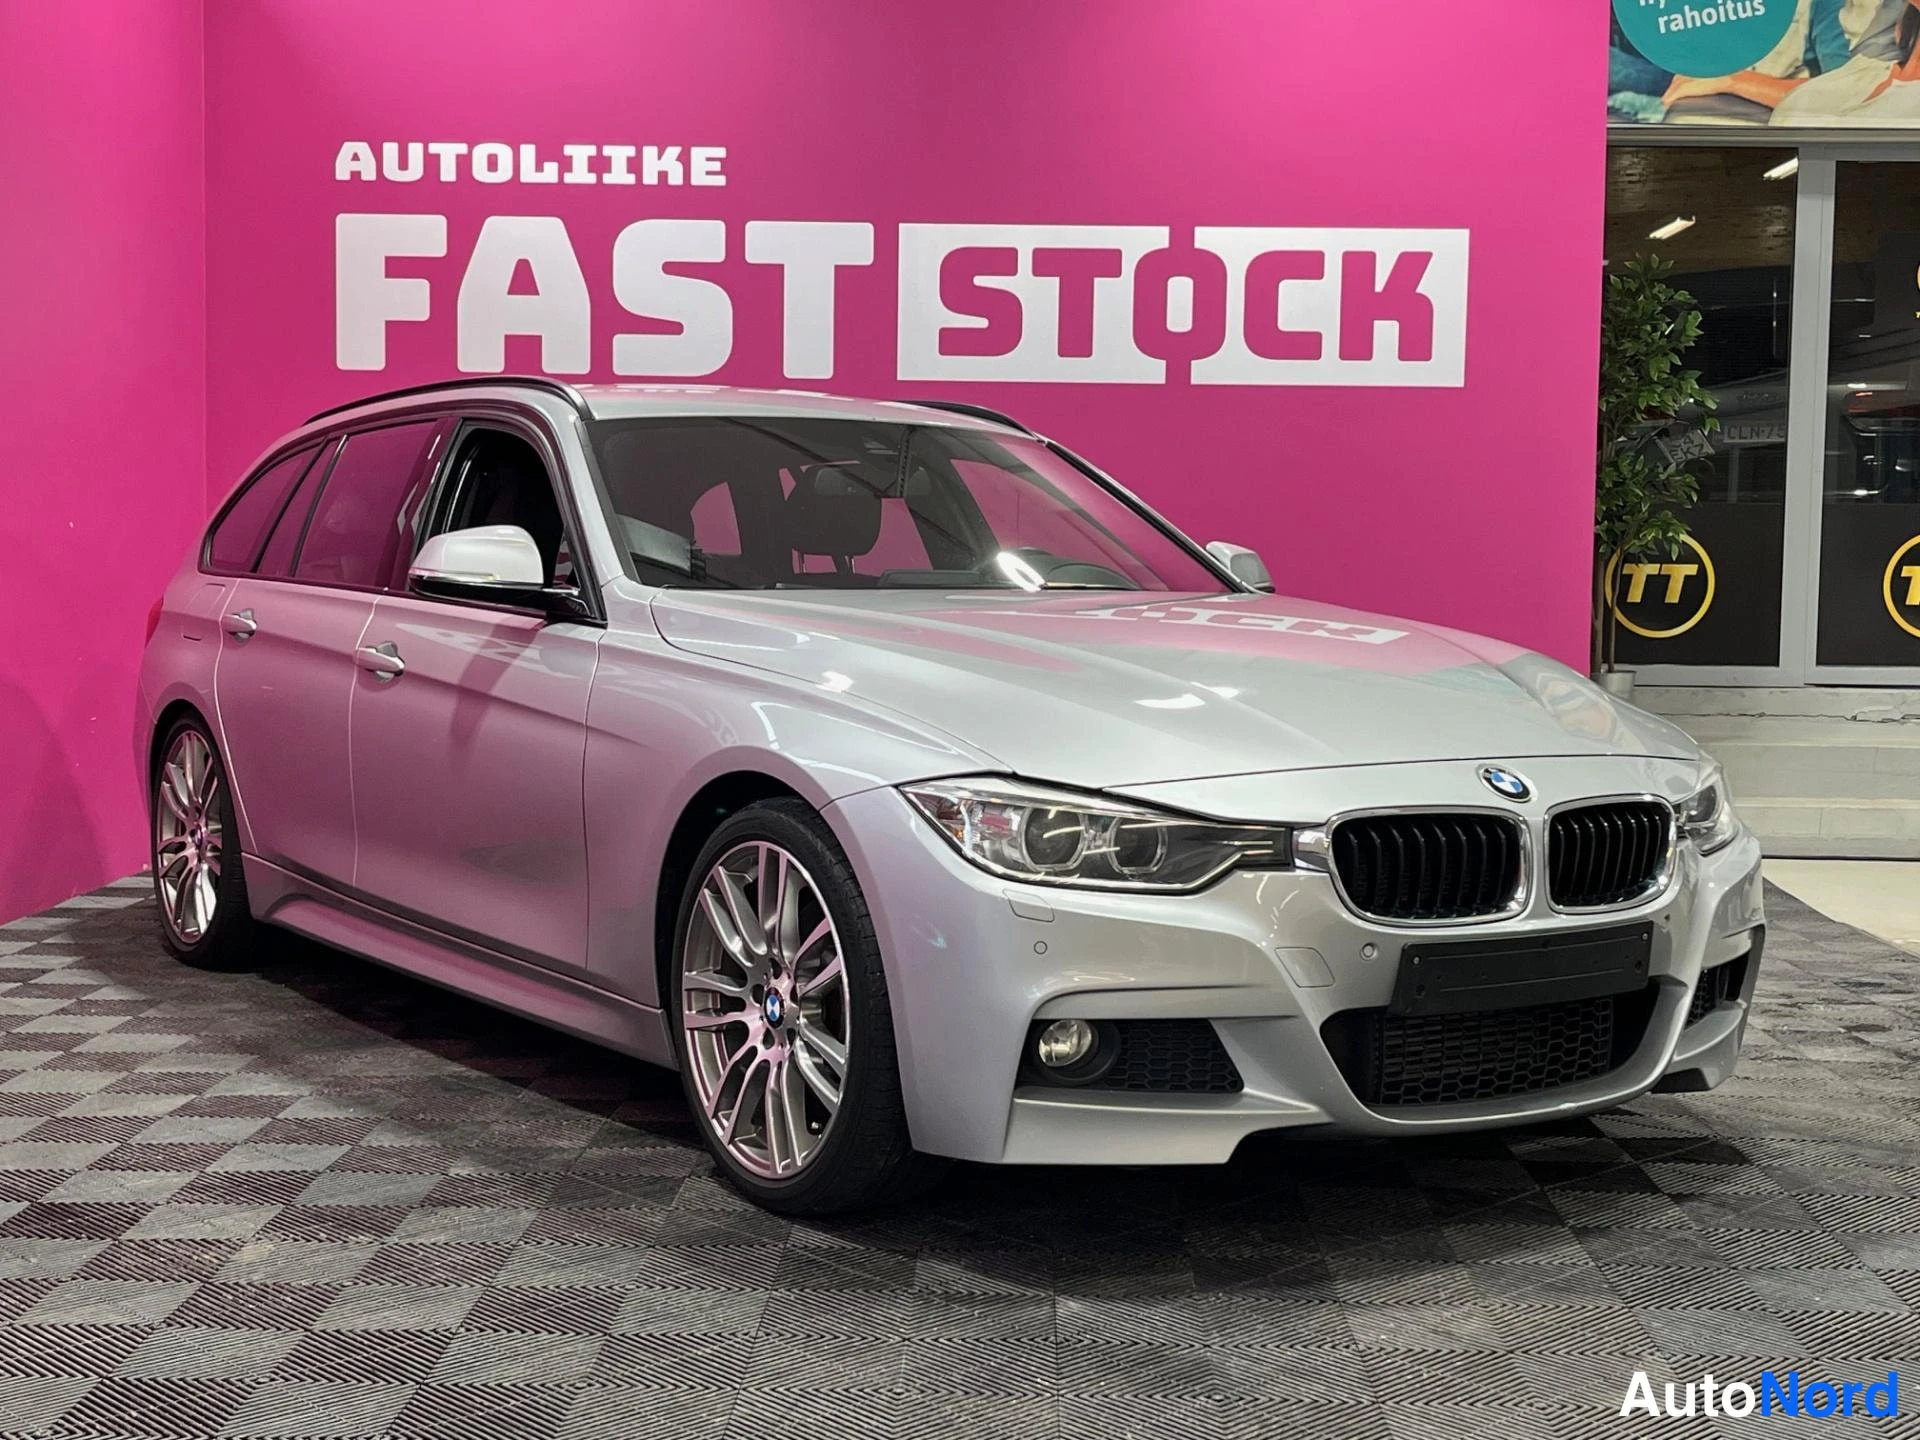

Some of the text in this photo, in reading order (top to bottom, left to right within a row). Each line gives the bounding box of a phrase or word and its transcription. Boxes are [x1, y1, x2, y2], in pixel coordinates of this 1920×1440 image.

[1658, 0, 1765, 34] rahoitus
[335, 141, 727, 186] AUTOLIIKE
[335, 213, 1434, 379] FAST STOCK
[1622, 563, 1698, 603] TT
